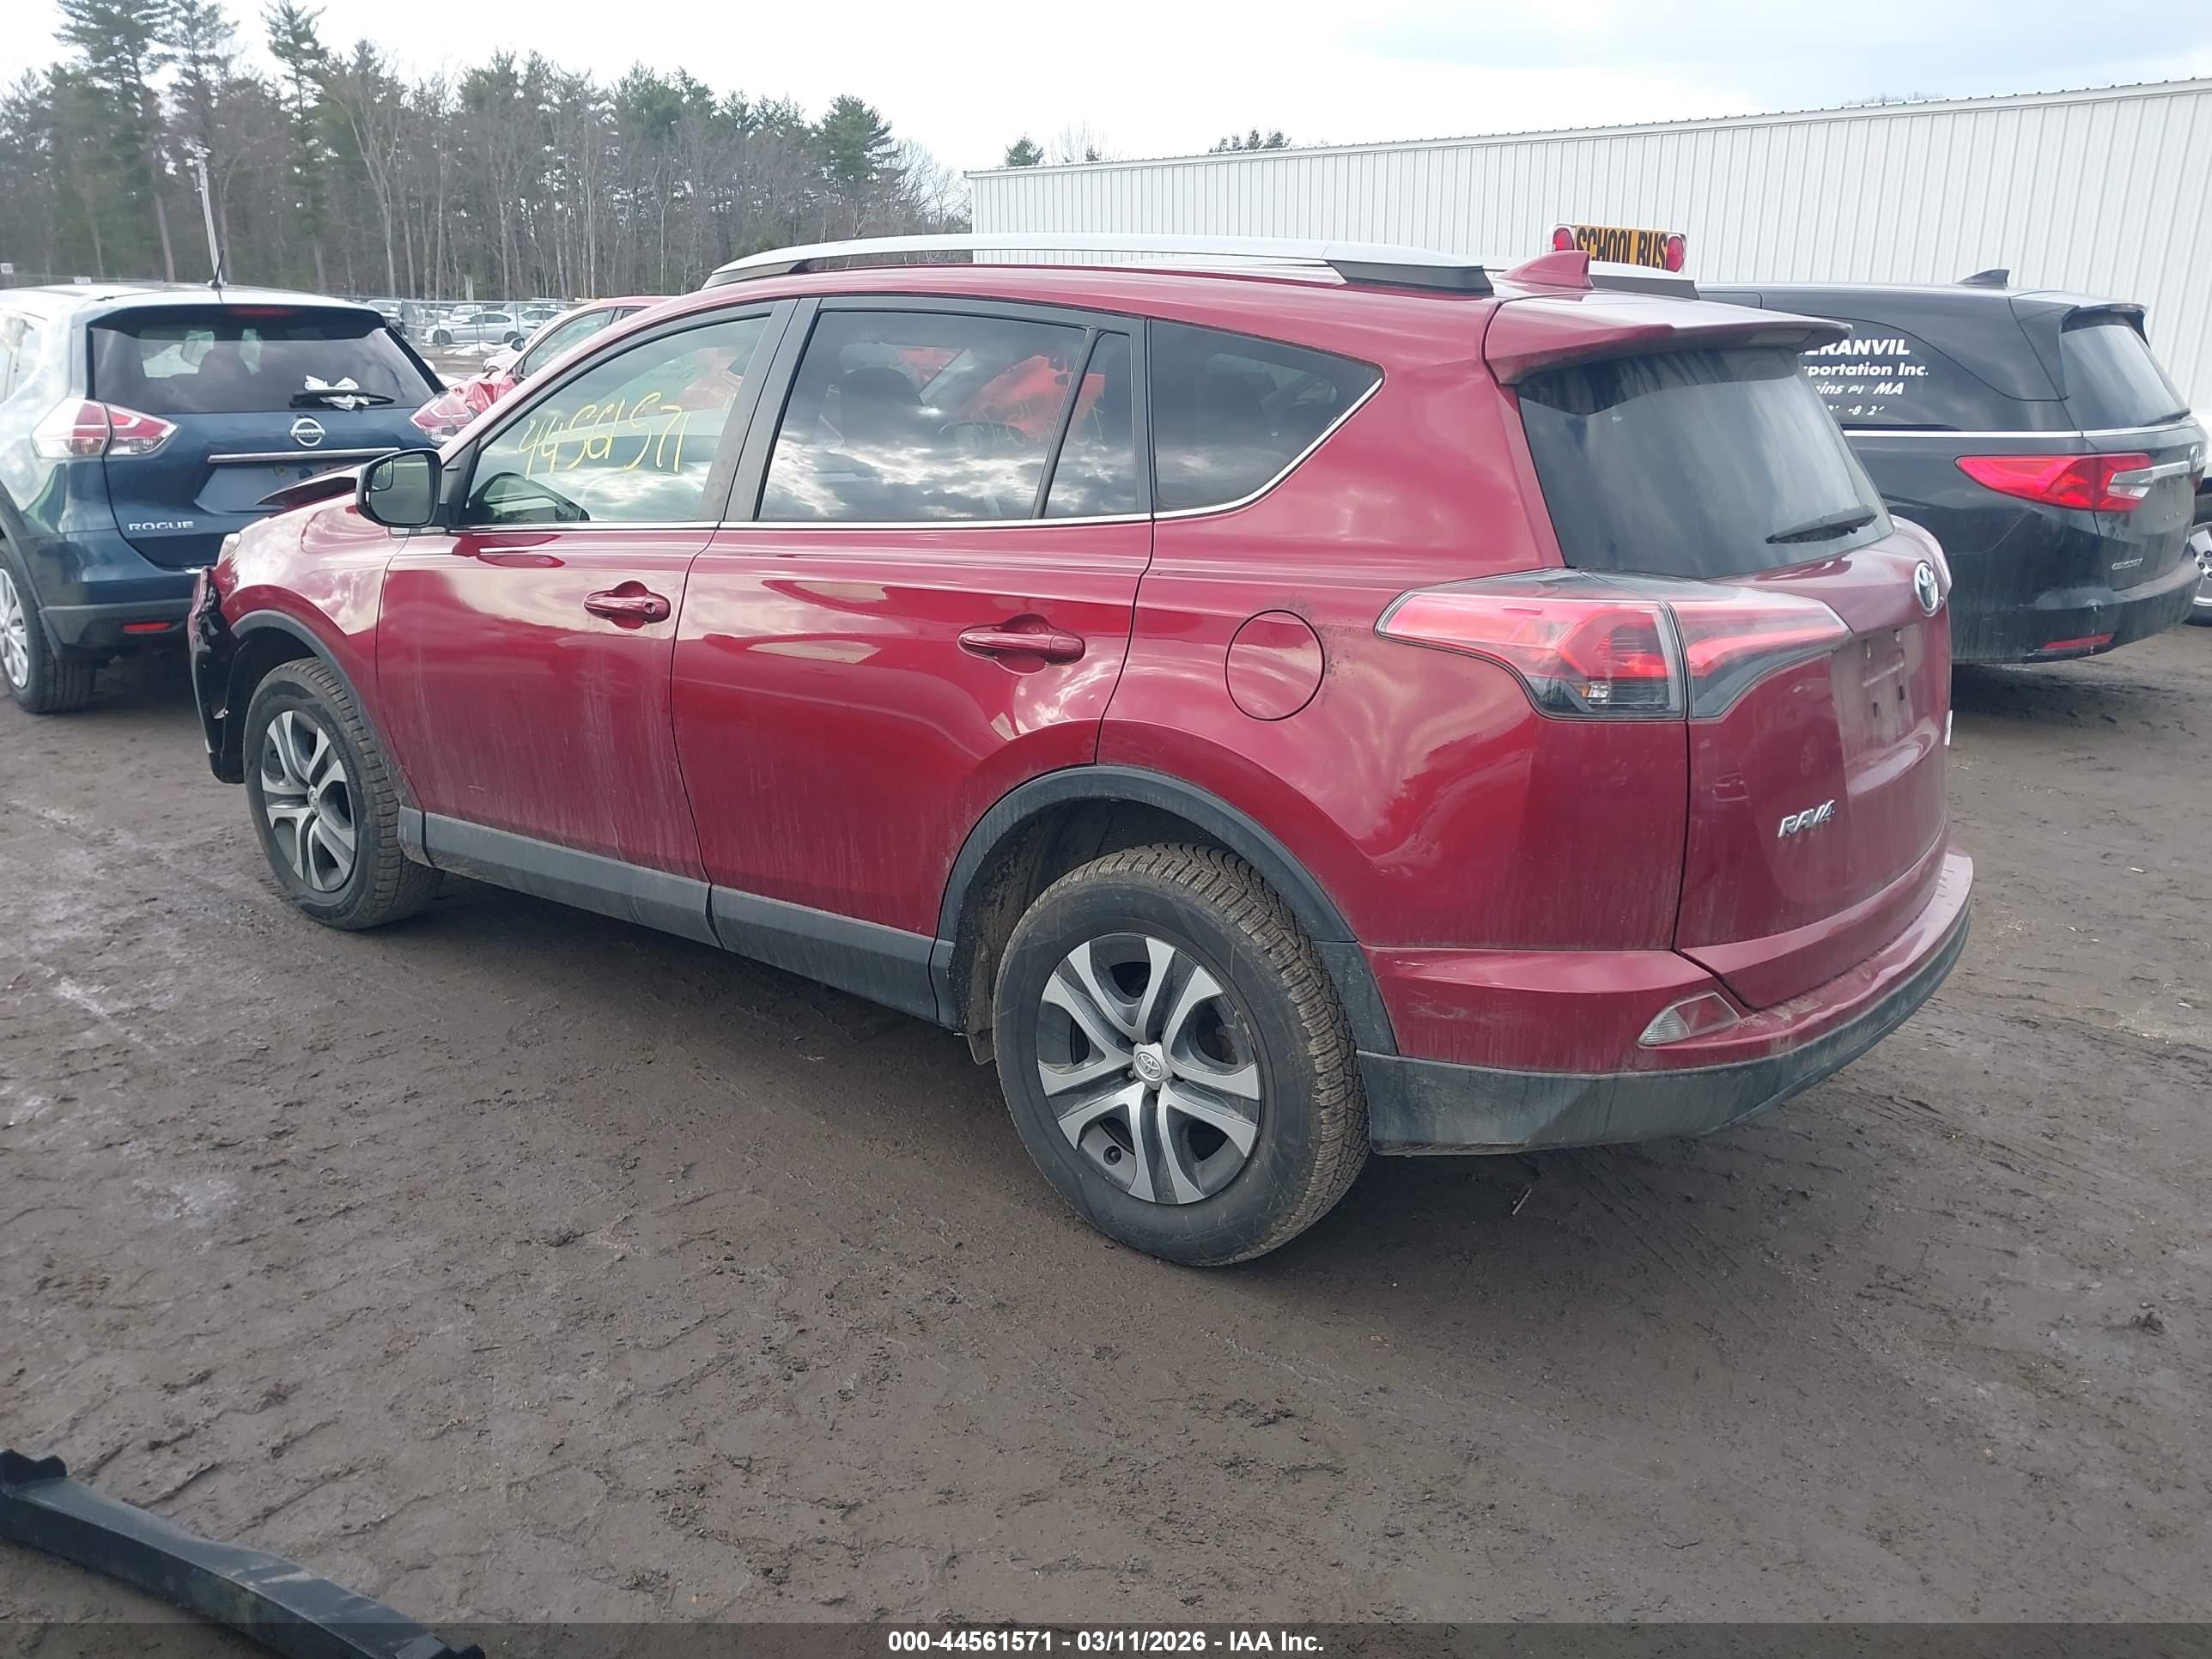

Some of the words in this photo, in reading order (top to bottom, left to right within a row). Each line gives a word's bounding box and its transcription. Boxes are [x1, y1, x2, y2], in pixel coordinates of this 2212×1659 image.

[1637, 231, 1668, 270] BUS
[1800, 339, 1911, 356] RANVIL
[1804, 361, 1893, 378] portation
[1898, 362, 1929, 376] Inc.
[1816, 381, 1844, 394] ins
[1873, 382, 1905, 395] MA
[128, 520, 194, 531] ROGUE
[1778, 799, 1835, 838] RAV4
